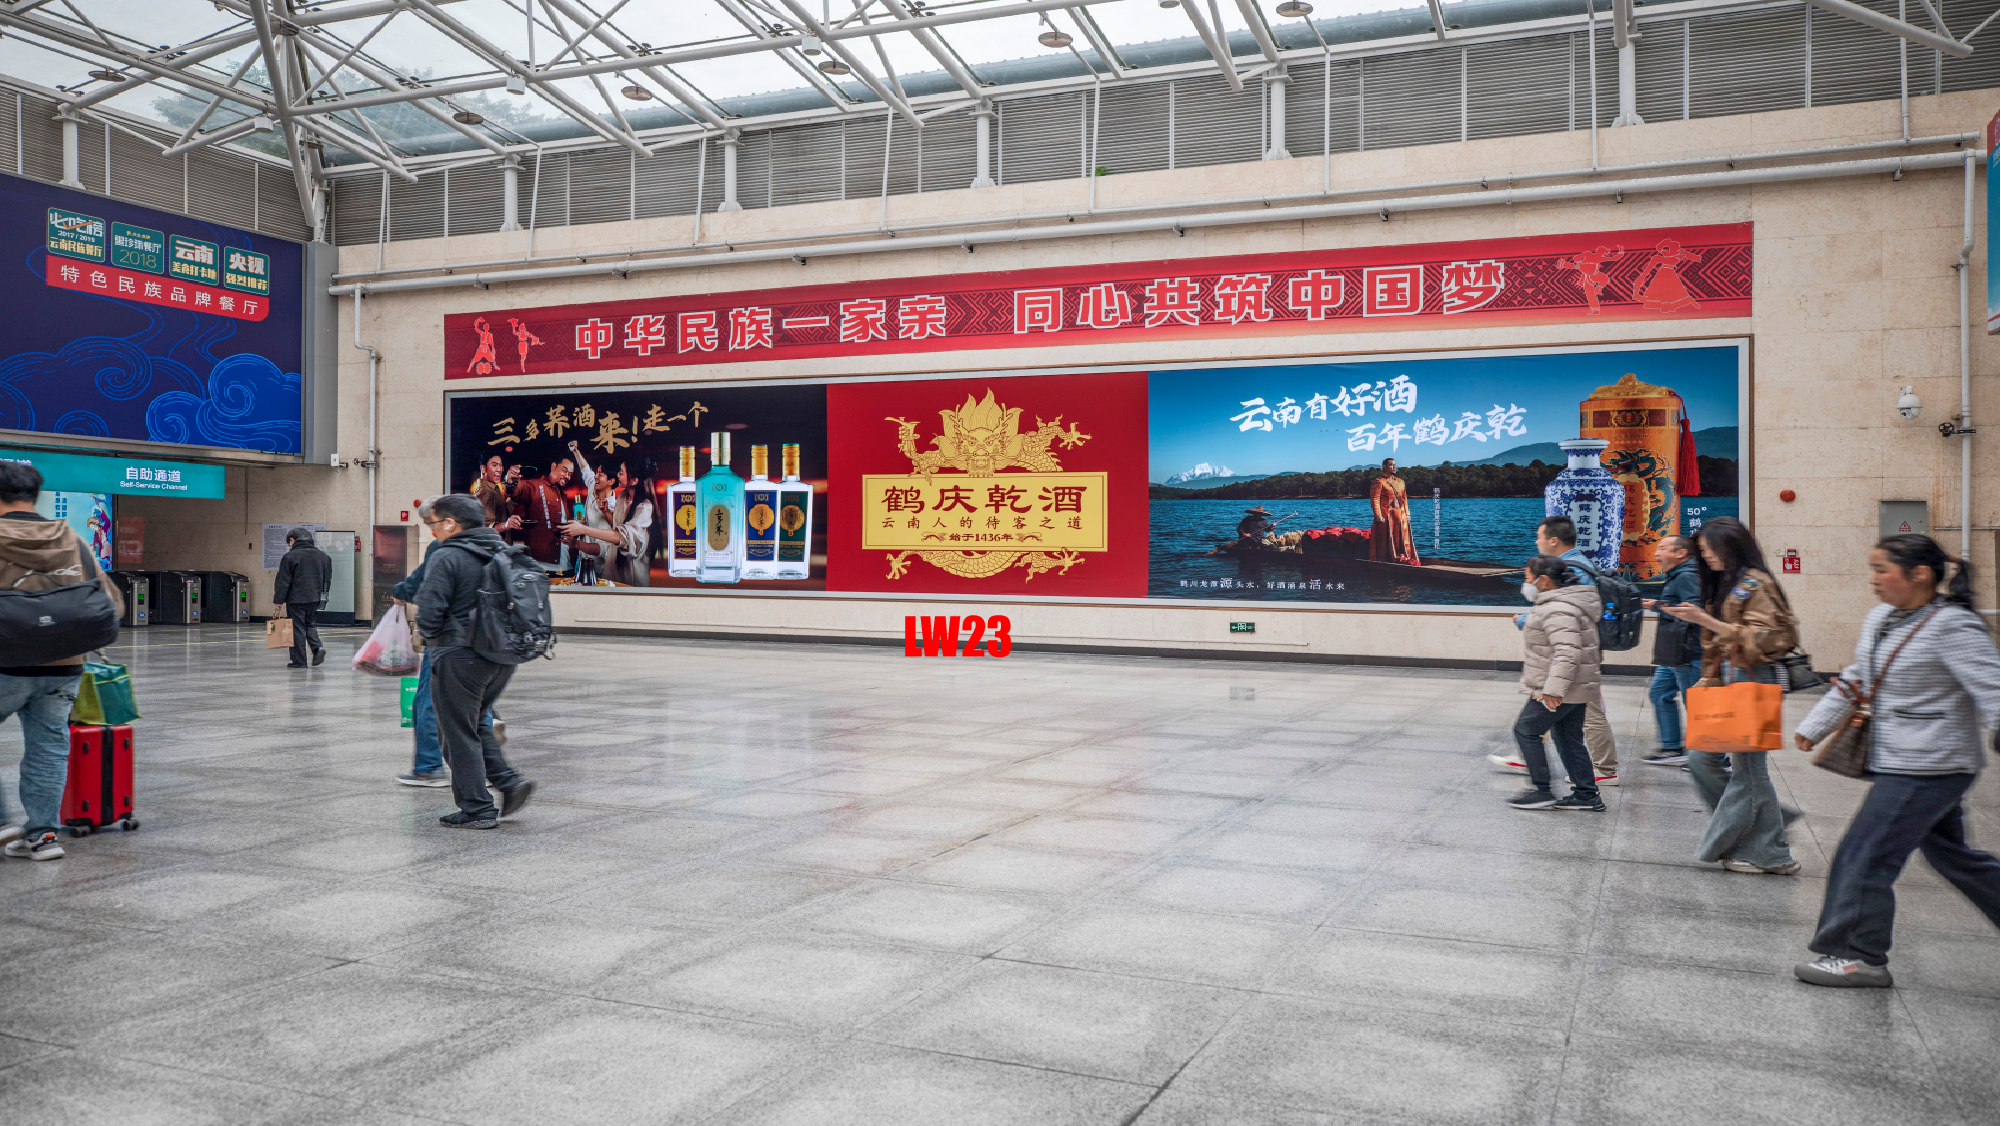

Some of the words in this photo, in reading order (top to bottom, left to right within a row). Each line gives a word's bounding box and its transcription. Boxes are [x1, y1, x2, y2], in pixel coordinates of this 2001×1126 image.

[50, 236, 103, 258] 云南民族餐厅
[175, 240, 214, 265] 云南
[119, 249, 157, 269] 2018
[229, 252, 265, 275] 央视
[172, 261, 218, 280] 美食打卡地
[226, 272, 268, 291] 强烈推荐
[60, 264, 258, 315] 特色民族品牌餐厅
[575, 296, 948, 360] 中华民族一家亲
[1013, 259, 1505, 334] 同心共筑中国梦
[1230, 374, 1418, 432] 云南有好酒
[1344, 403, 1528, 453] 百年鹤庆乾
[126, 466, 181, 483] 自助通道
[119, 481, 160, 489] Self-Service
[161, 483, 188, 491] Channel
[881, 484, 1088, 513] 鹤庆乾酒
[881, 516, 1083, 530] 云南人的待客之道
[1577, 503, 1593, 547] 鹤庆乾酒
[949, 533, 1014, 542] 始于1436年
